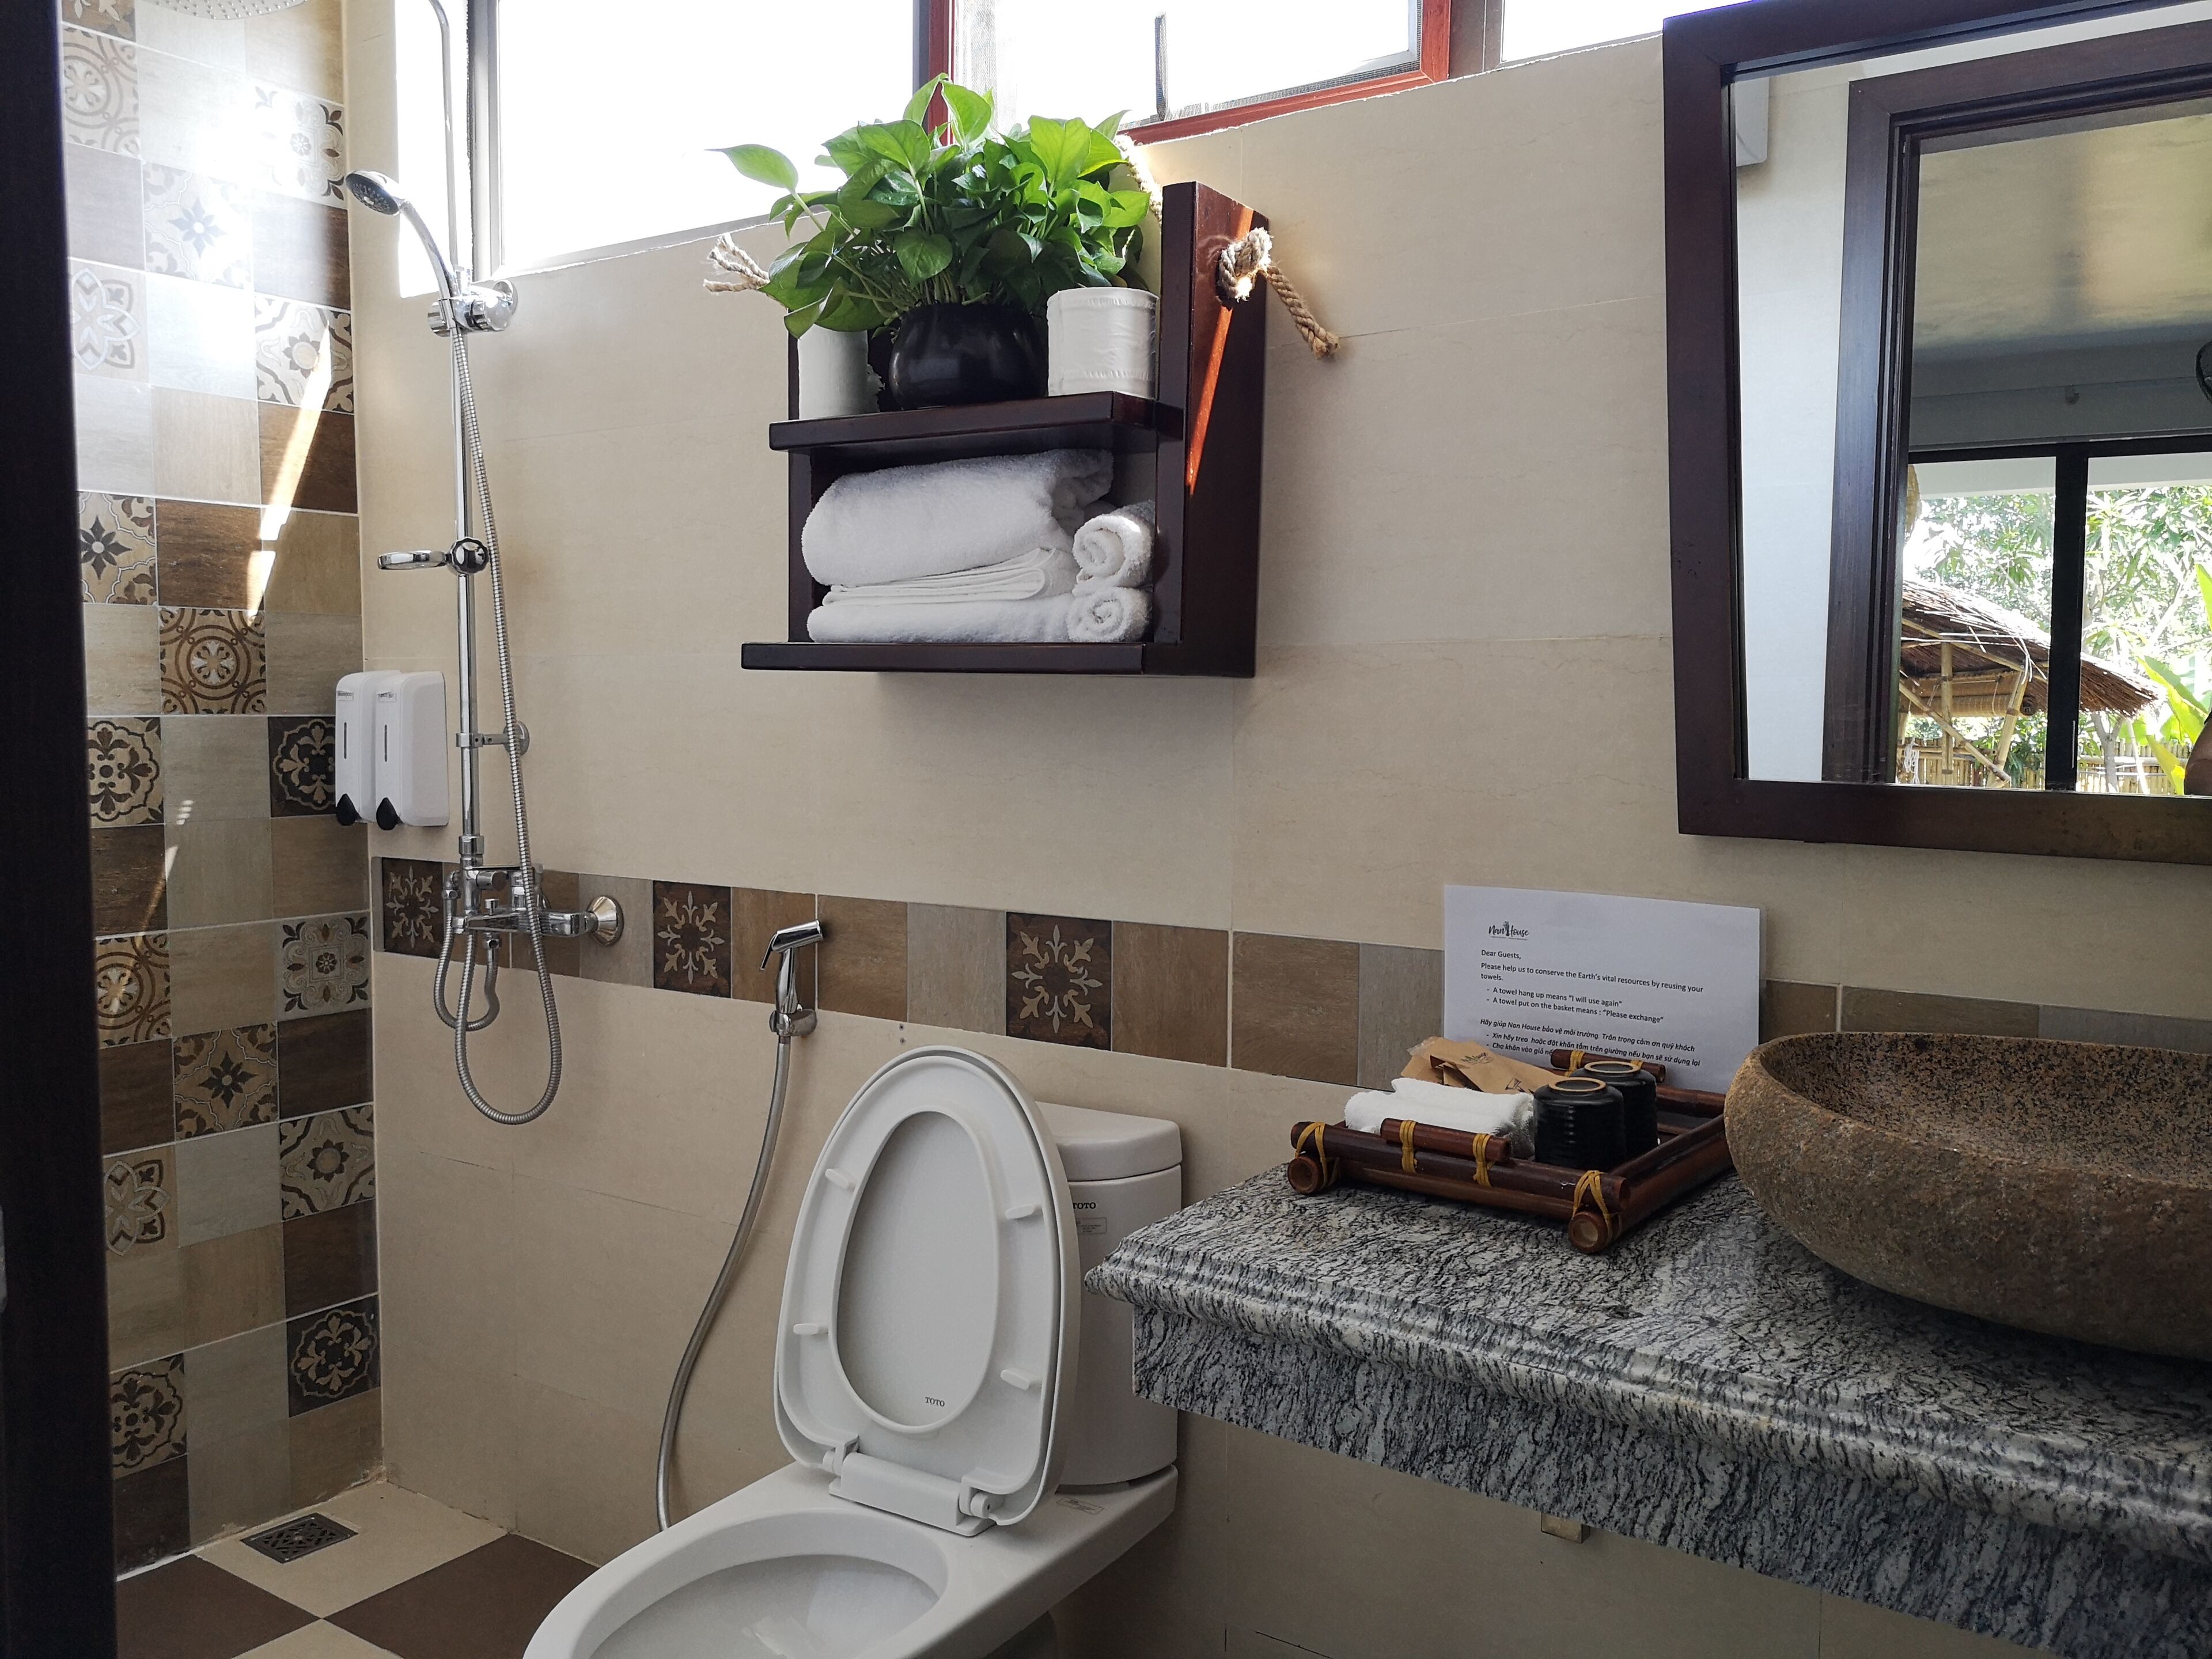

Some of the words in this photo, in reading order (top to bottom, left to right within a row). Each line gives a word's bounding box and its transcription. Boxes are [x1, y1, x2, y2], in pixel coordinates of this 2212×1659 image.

[1498, 951, 1521, 959] Guests,
[1535, 969, 1564, 977] conserve
[1618, 977, 1649, 986] resources
[1652, 980, 1660, 988] by
[1662, 982, 1686, 992] reusing
[1519, 990, 1534, 998] hang
[1553, 1003, 1574, 1012] basket
[1618, 1036, 1635, 1044] trọng
[1675, 1043, 1695, 1052] khách
[1674, 1057, 1690, 1066] dụng
[925, 1397, 945, 1407] TOTO
